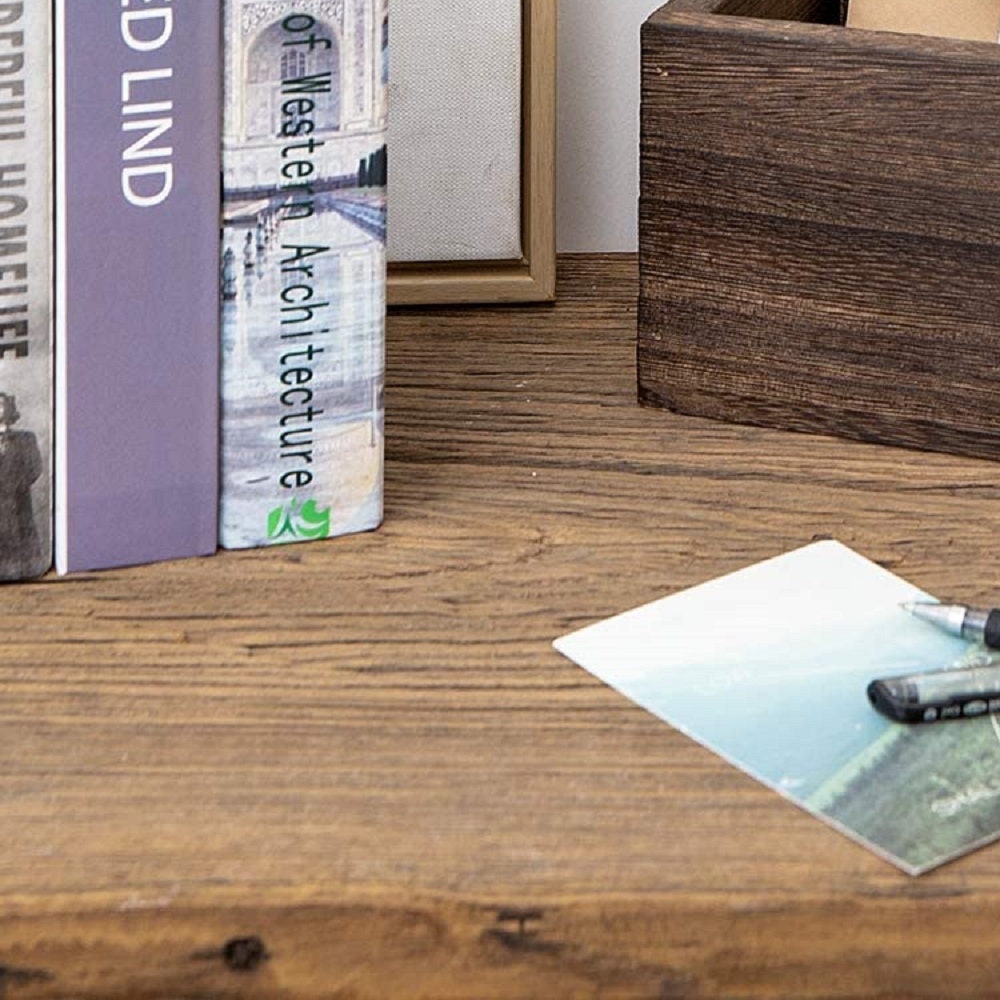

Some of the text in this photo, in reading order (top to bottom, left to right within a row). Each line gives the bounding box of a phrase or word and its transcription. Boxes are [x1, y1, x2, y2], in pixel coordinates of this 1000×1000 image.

[281, 12, 332, 51] of
[120, 67, 174, 207] LIND
[280, 71, 332, 222] Western
[279, 243, 331, 489] Architecture
